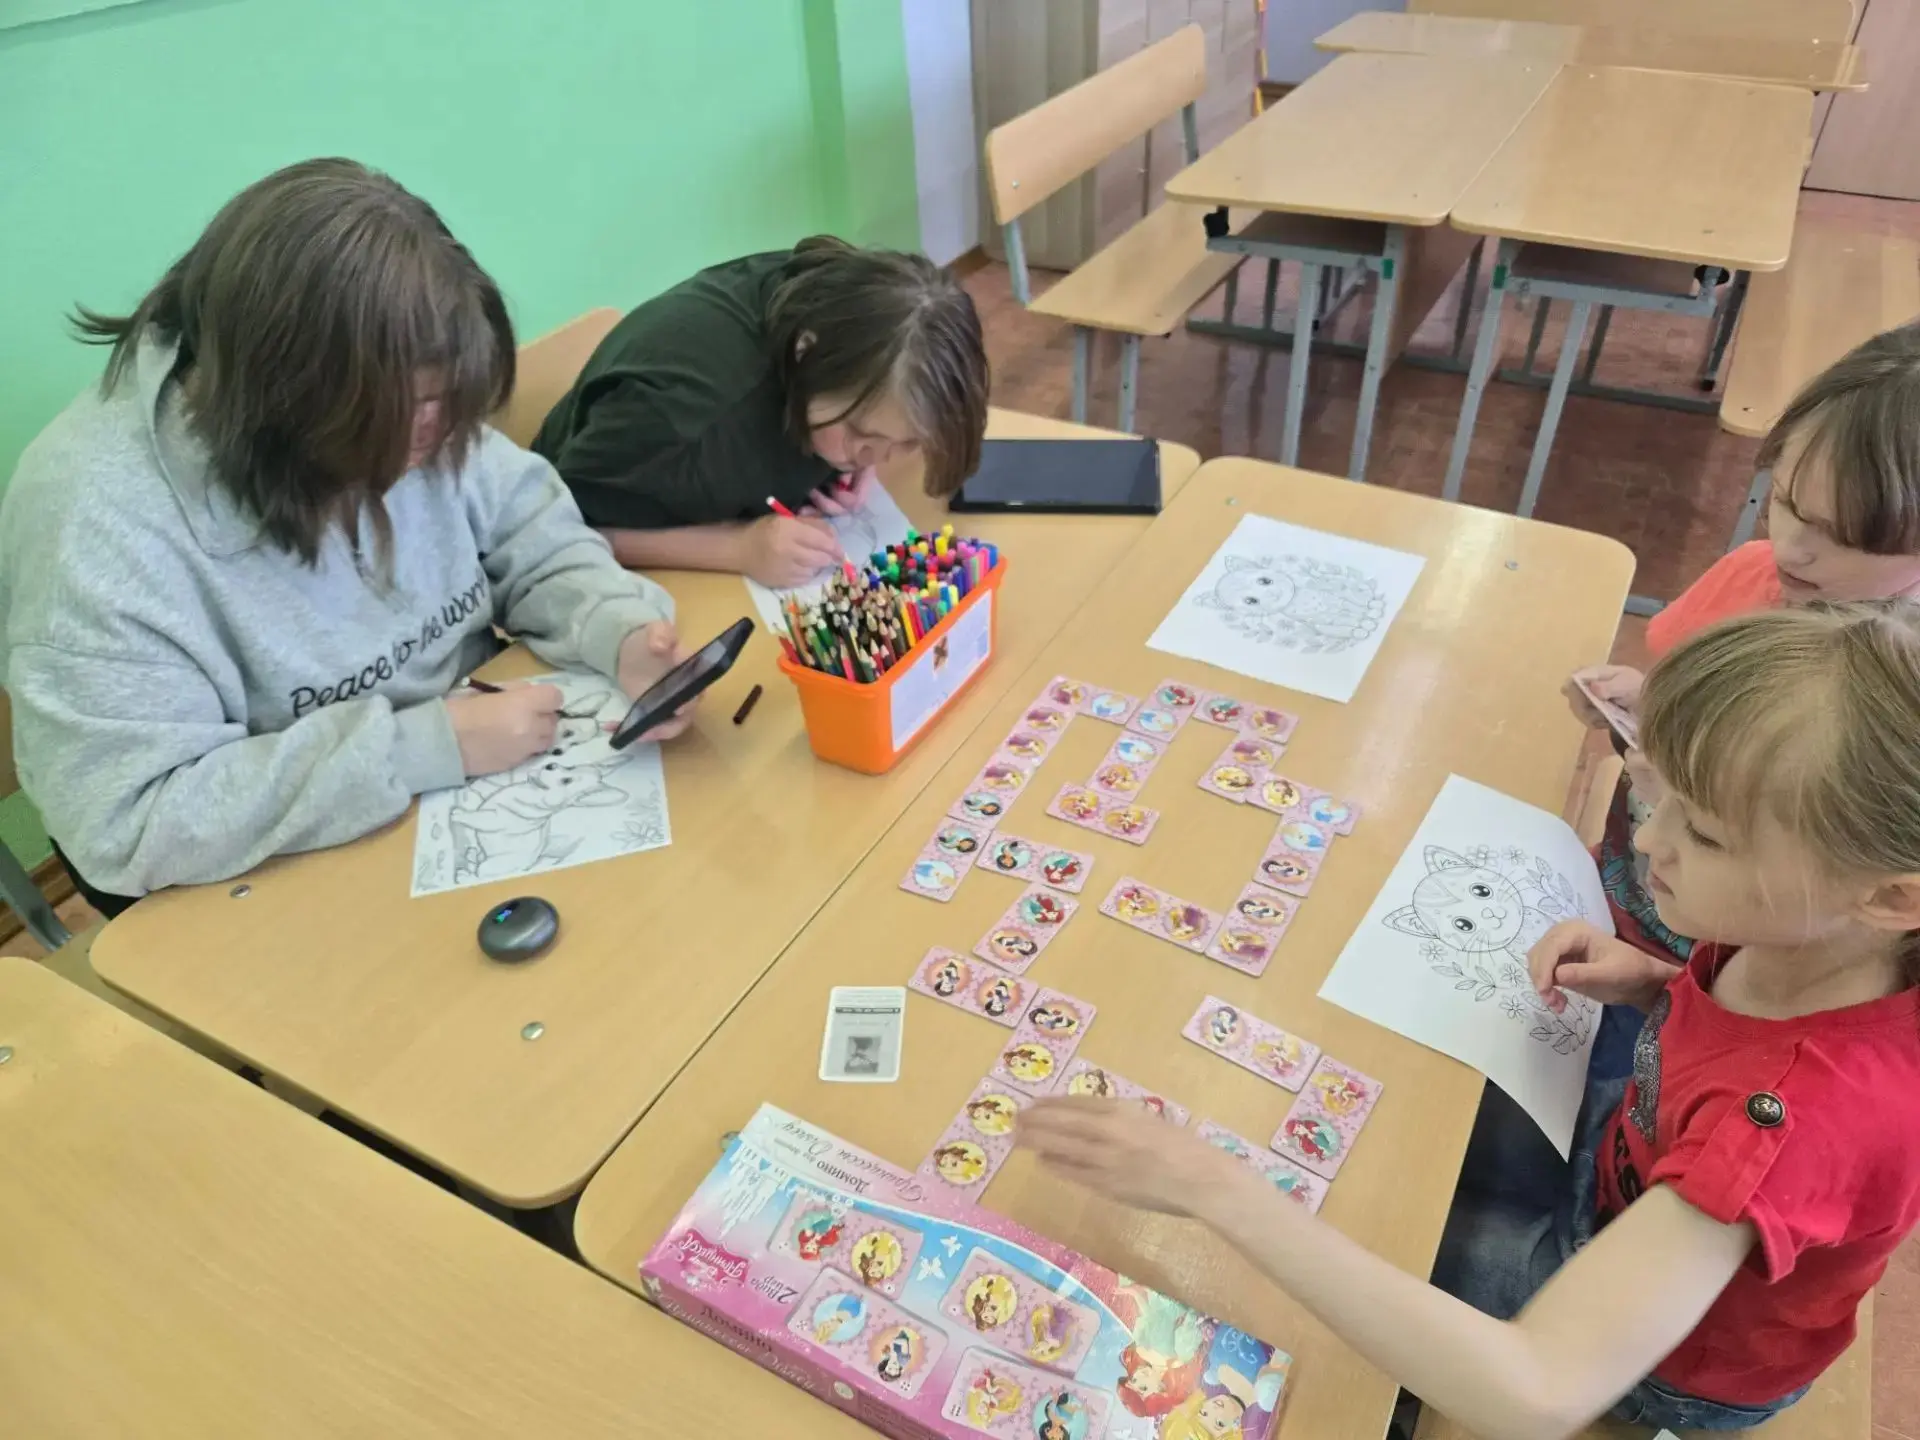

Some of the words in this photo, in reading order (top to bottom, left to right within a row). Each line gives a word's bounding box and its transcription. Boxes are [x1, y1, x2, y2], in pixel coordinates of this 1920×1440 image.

[290, 655, 394, 718] Peace
[816, 1160, 870, 1194] Домино
[776, 1286, 799, 1305] 2
